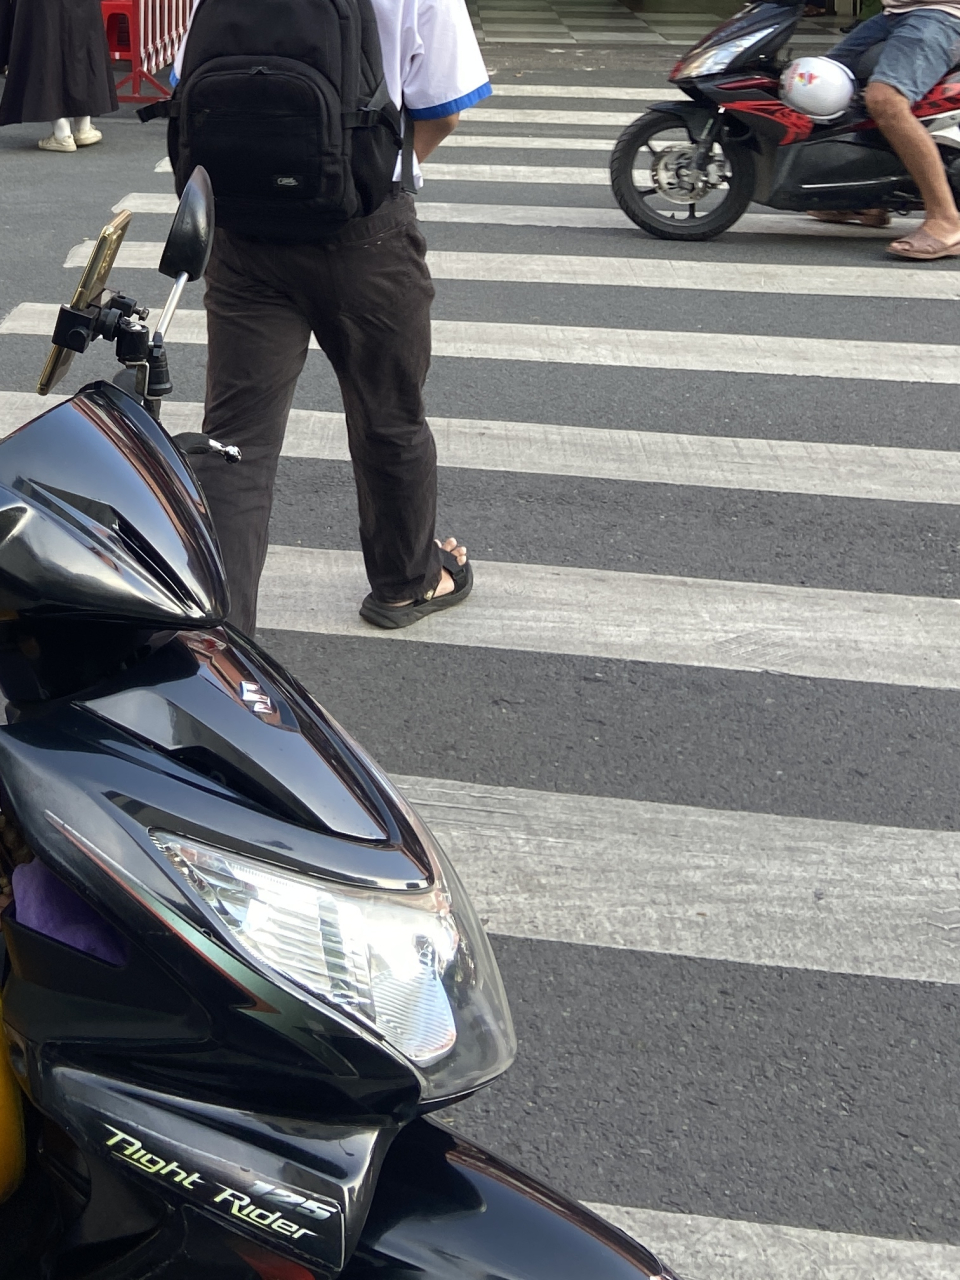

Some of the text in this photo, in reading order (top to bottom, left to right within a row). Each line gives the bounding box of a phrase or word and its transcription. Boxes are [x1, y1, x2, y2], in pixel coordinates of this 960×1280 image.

[101, 1122, 322, 1240] Night Rider
[248, 1179, 340, 1221] 125
